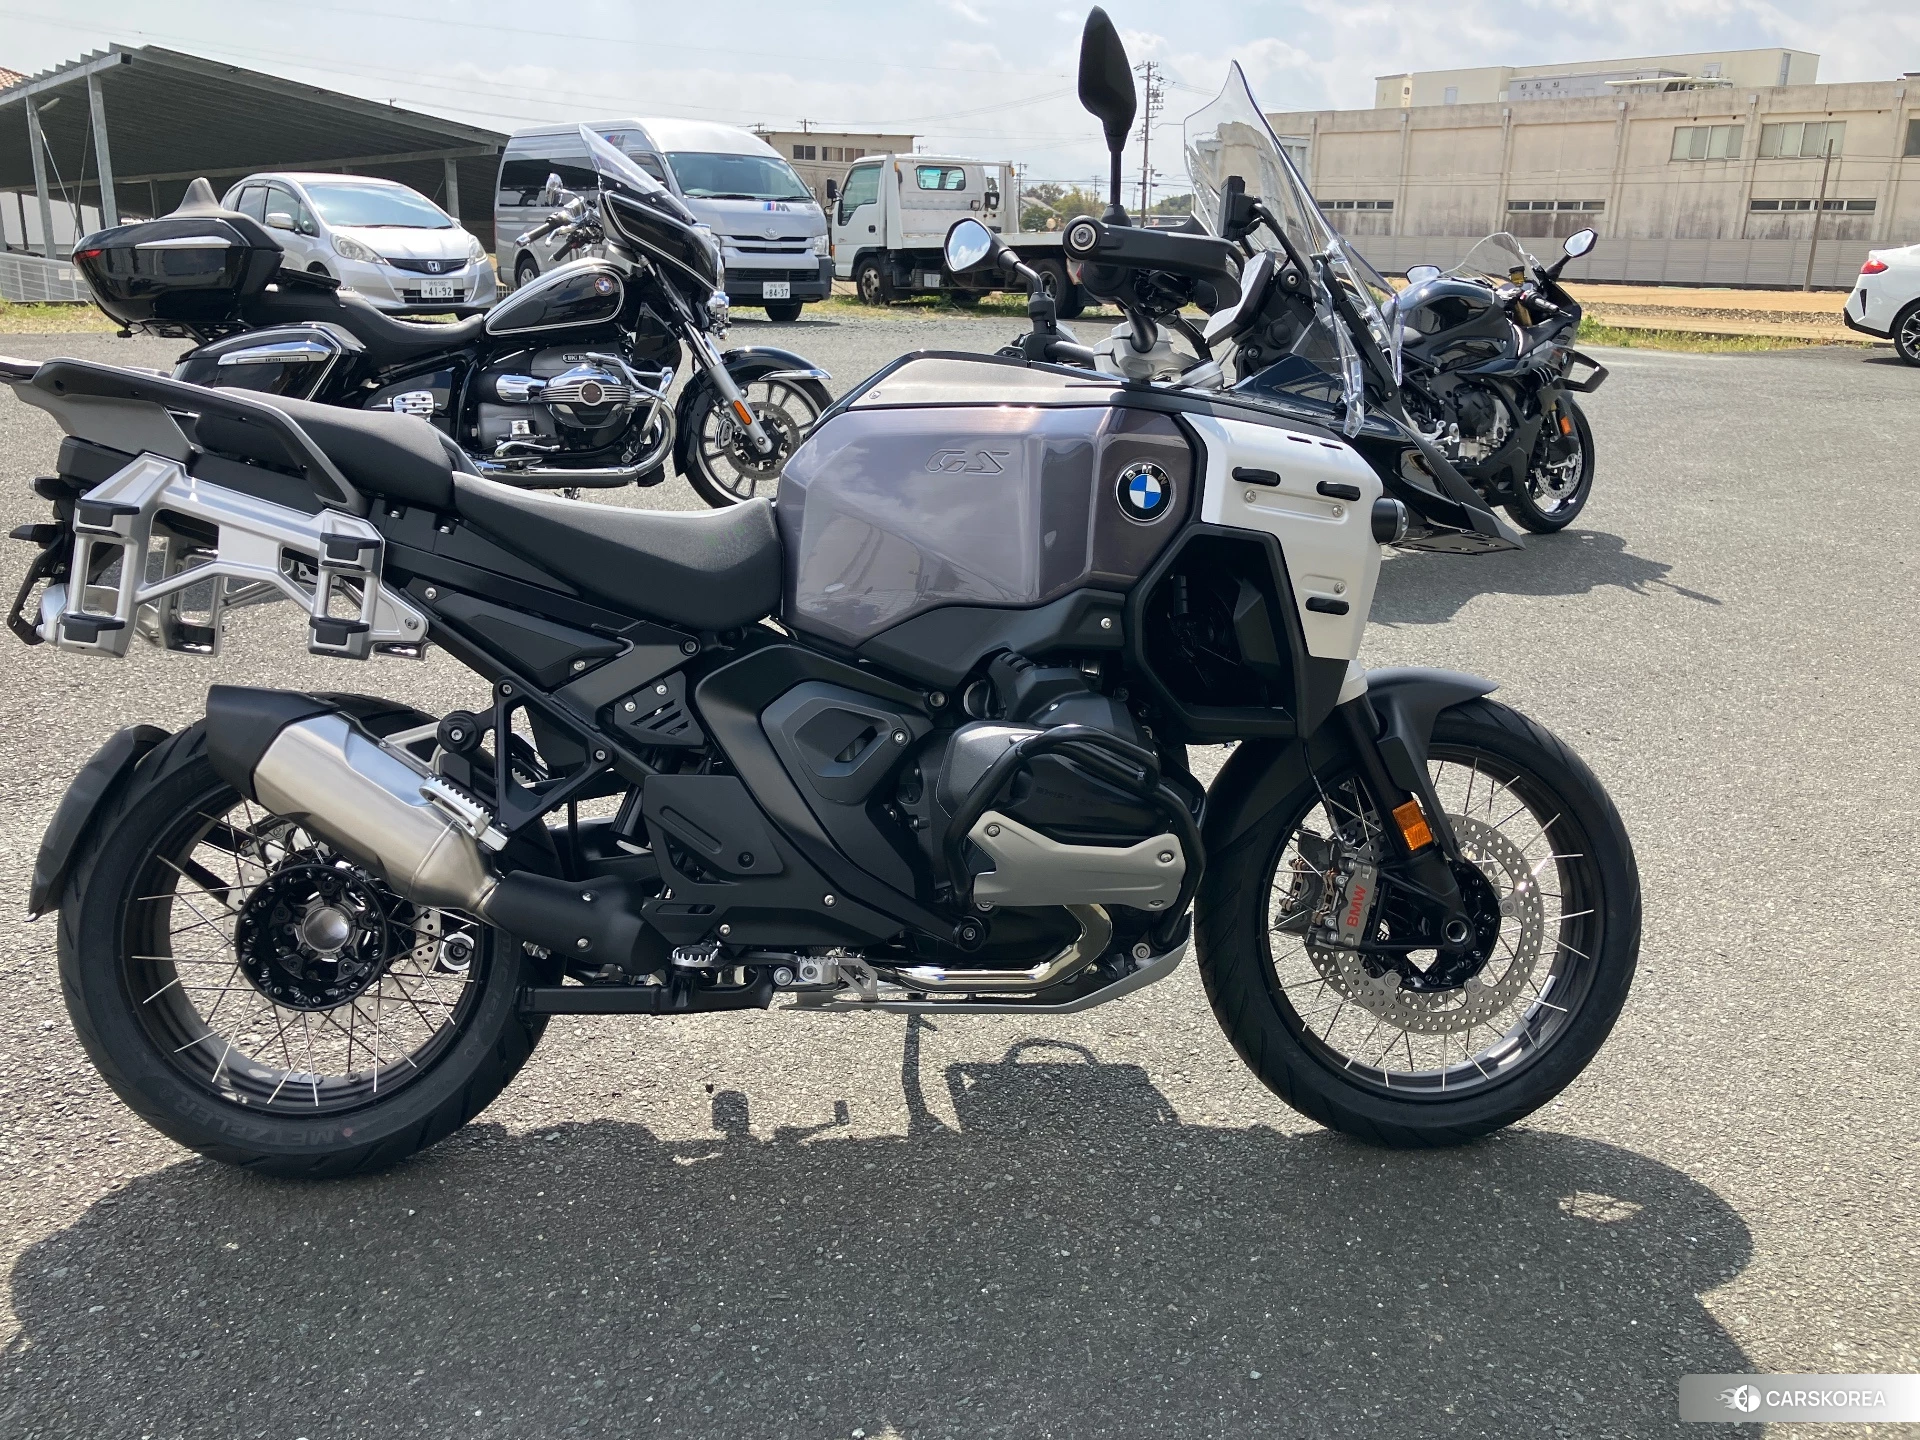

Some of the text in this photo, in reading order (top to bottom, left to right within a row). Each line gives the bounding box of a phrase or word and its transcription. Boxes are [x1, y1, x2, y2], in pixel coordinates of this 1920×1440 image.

[925, 448, 1010, 475] GS
[1125, 464, 1168, 485] BMW
[1346, 884, 1367, 927] BMW
